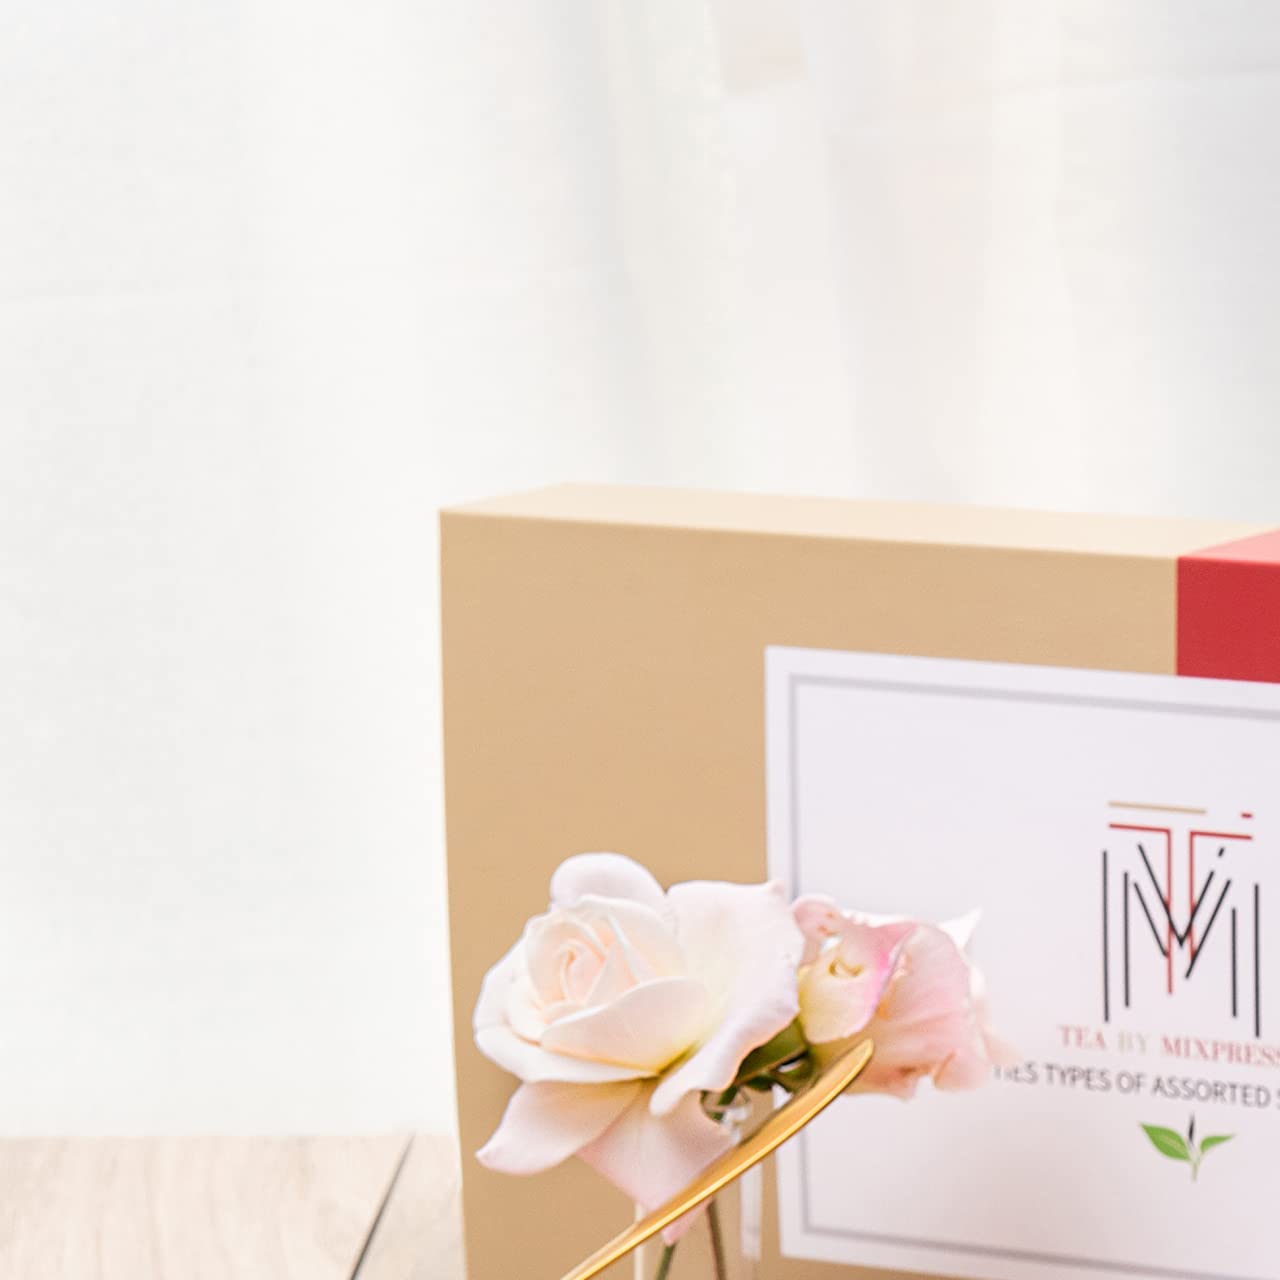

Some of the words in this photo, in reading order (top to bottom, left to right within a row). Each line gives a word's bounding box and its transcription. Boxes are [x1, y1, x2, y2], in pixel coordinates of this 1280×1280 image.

[1058, 1023, 1107, 1050] TEA
[1118, 1030, 1151, 1053] BY
[1044, 1062, 1112, 1093] TYPES
[1115, 1070, 1147, 1094] OF
[1151, 1074, 1271, 1109] ASSORTED
